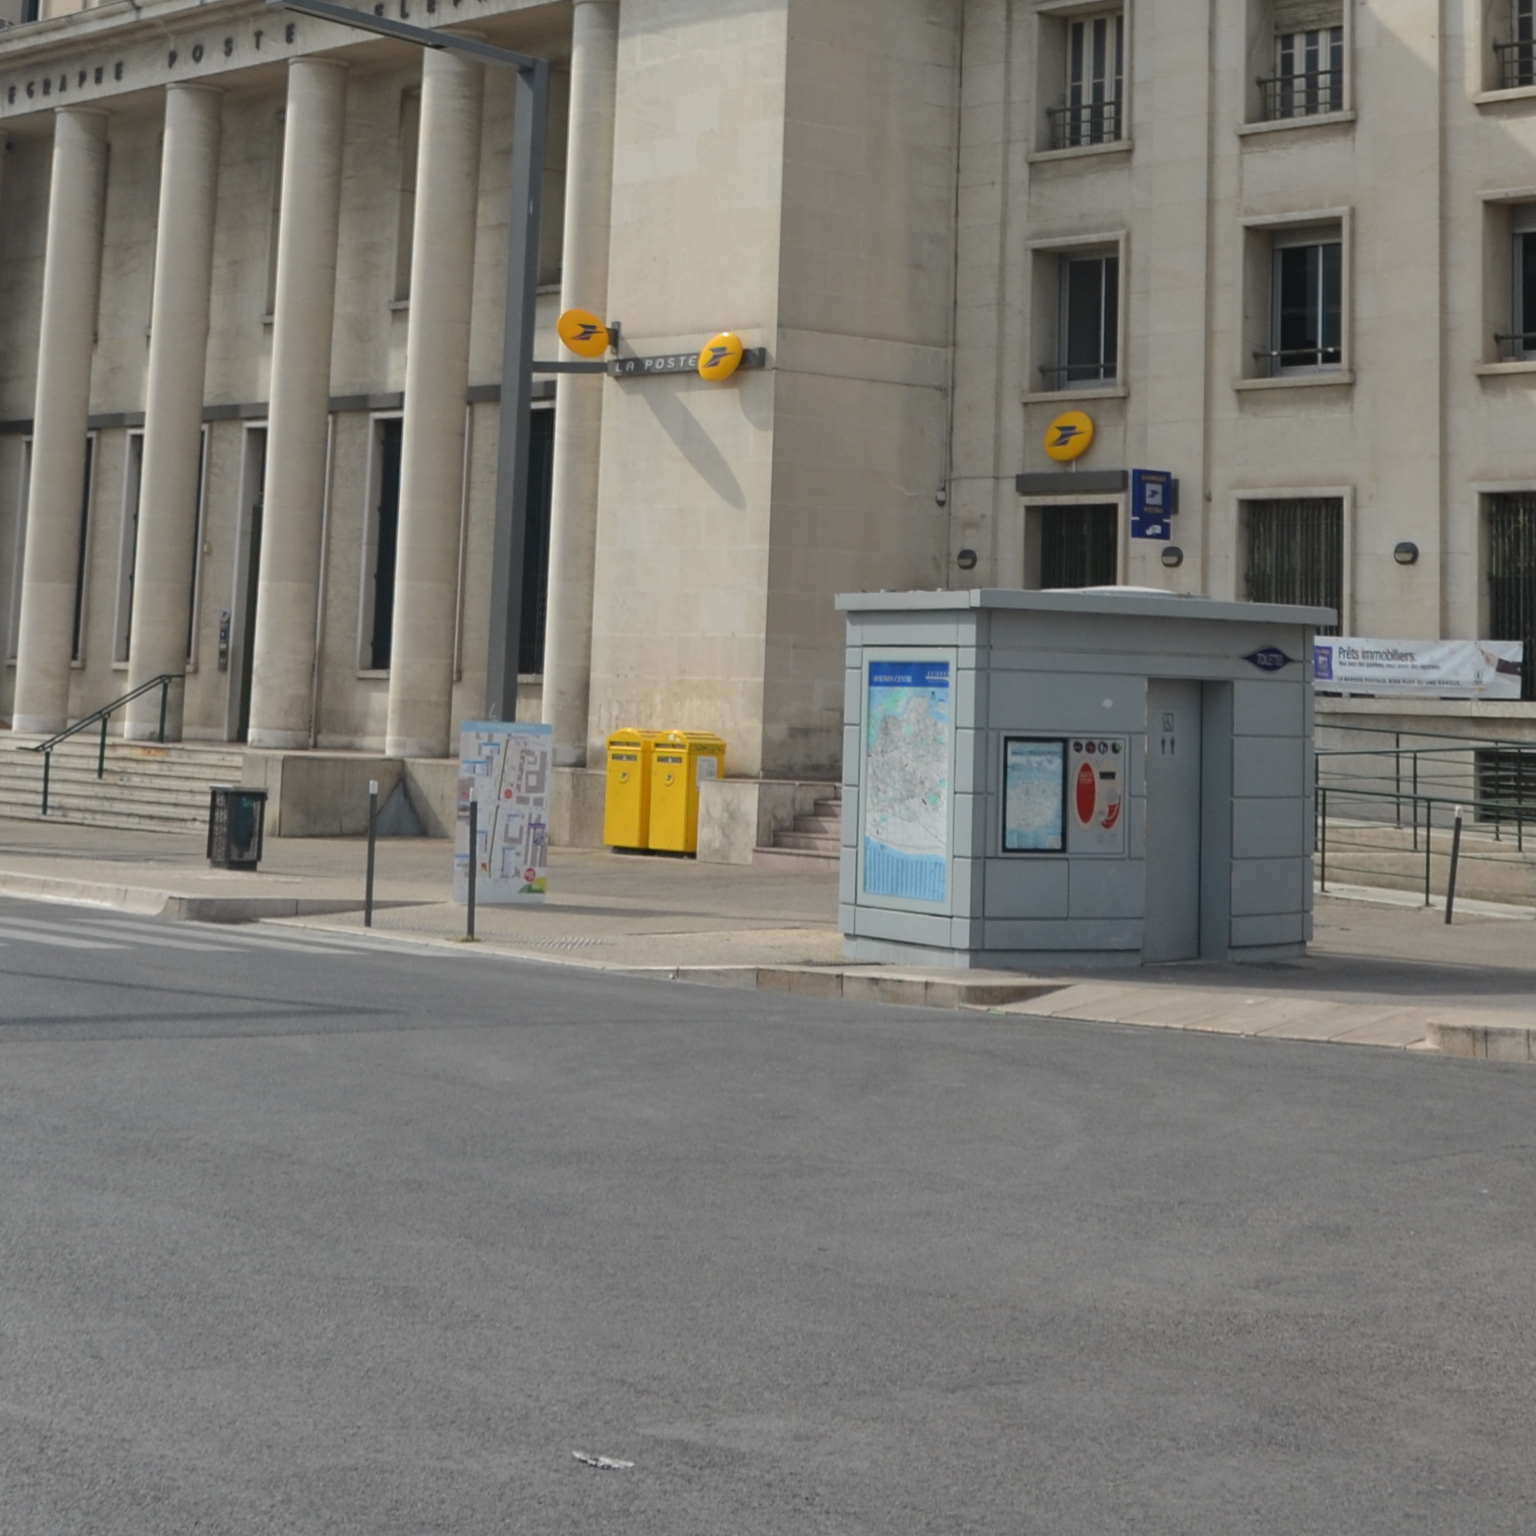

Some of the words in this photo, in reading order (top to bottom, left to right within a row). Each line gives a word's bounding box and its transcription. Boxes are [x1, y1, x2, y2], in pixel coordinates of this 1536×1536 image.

[167, 22, 296, 69] POSTE
[615, 361, 635, 373] LA
[644, 355, 697, 370] POSTE
[1338, 646, 1360, 660] Prêts
